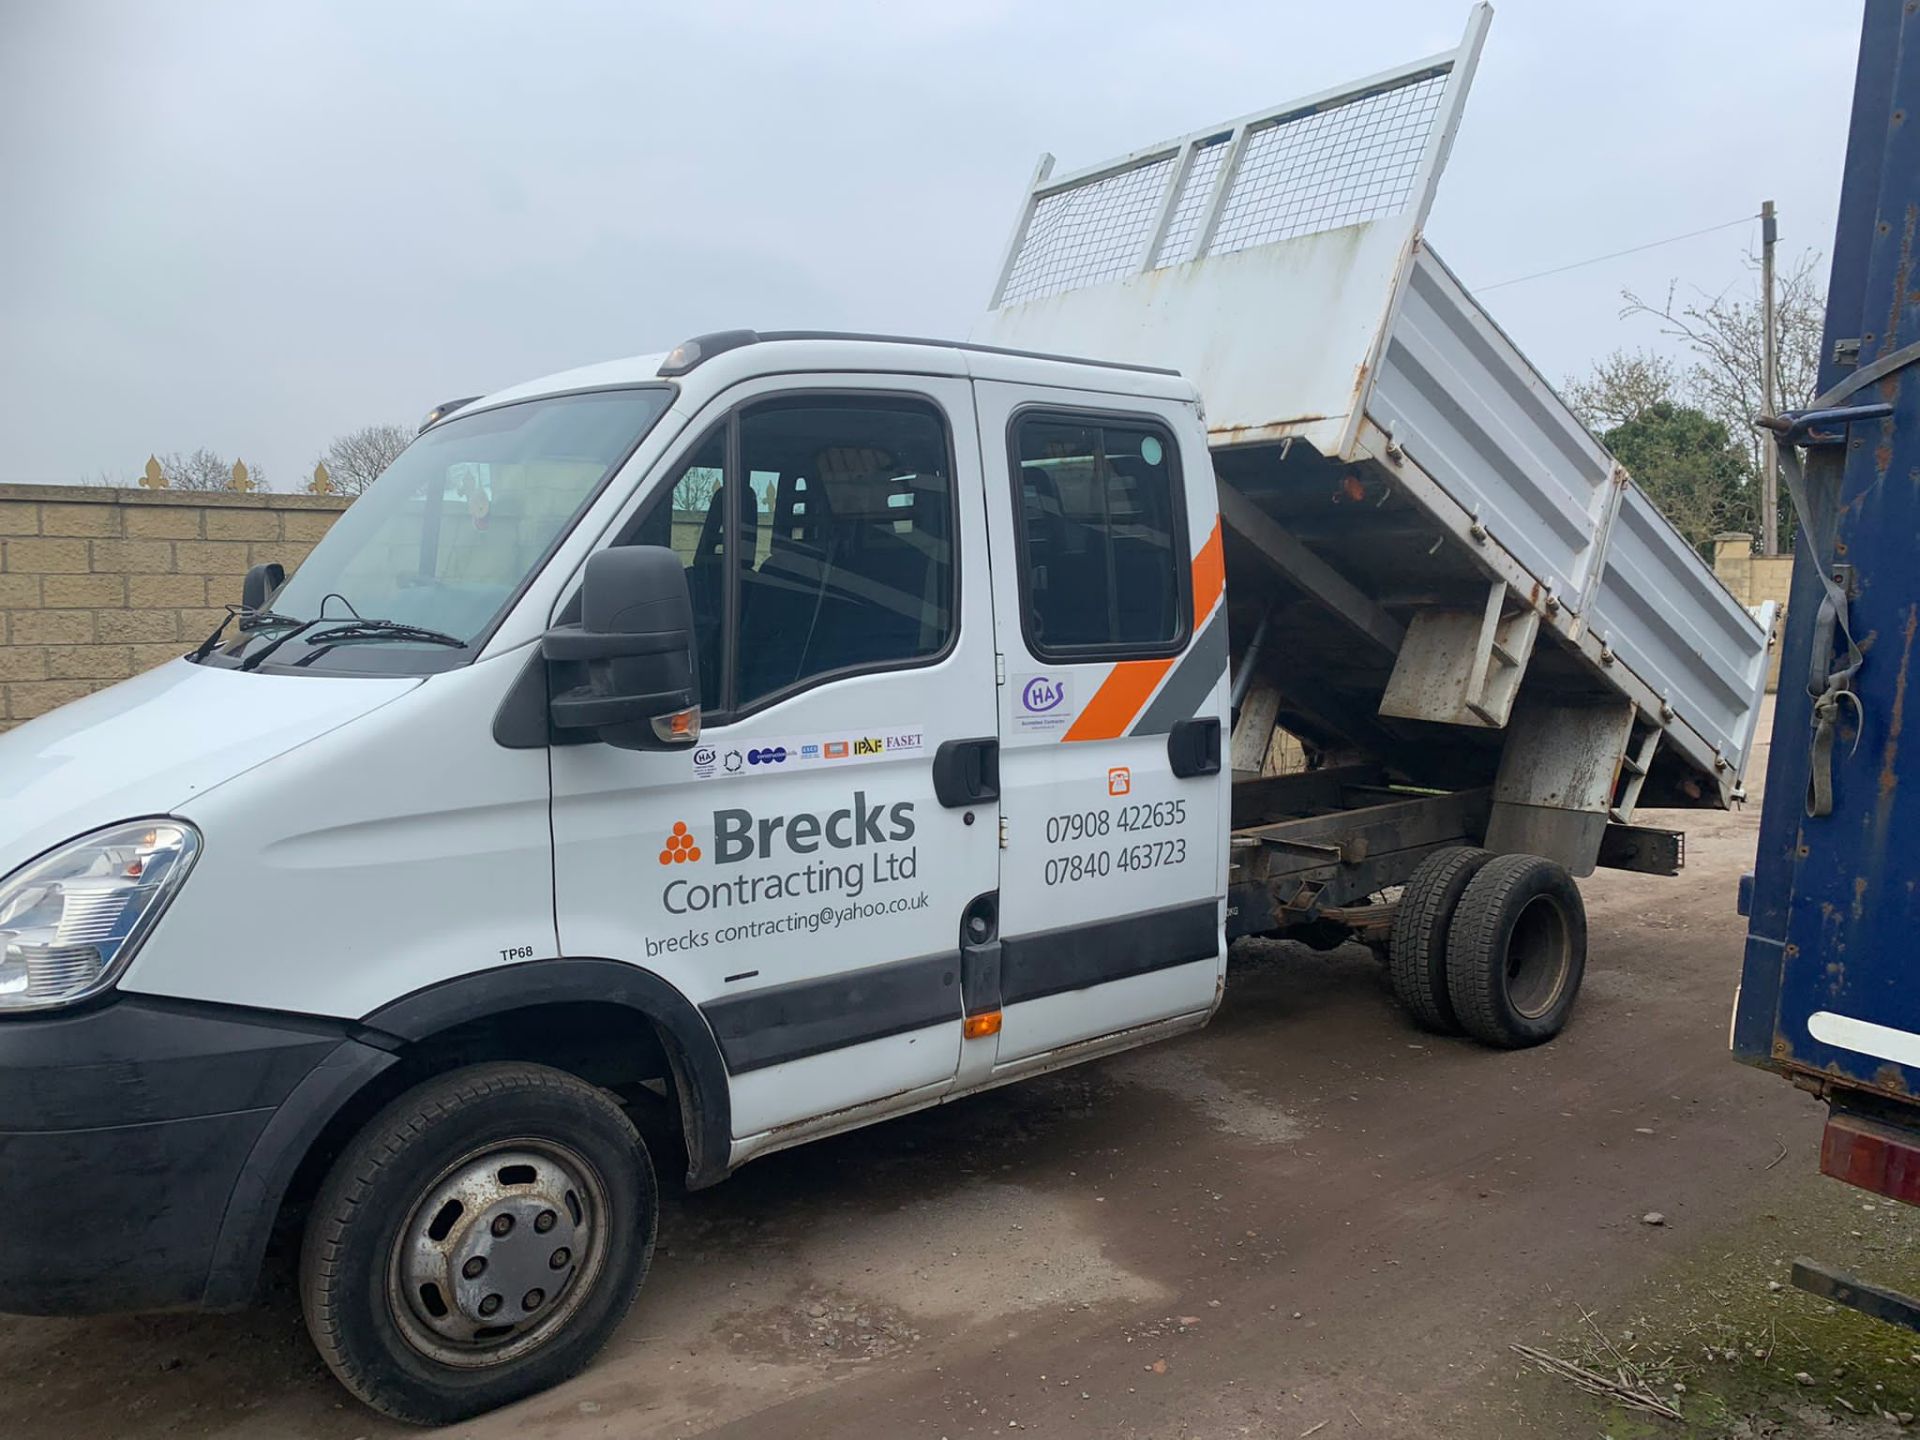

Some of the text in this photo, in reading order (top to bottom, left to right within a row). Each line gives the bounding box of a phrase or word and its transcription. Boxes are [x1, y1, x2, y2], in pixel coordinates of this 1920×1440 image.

[1022, 676, 1064, 712] CHAS
[693, 748, 716, 765] CHAS
[853, 736, 882, 755] IPAF
[886, 734, 923, 748] FASET
[713, 791, 915, 864] Brecks
[1046, 799, 1186, 843] 07908 422635
[662, 846, 917, 914] Contracting Ltd
[1045, 838, 1186, 886] 07840 463723
[645, 891, 929, 957] brecks contracting@yahoo.co.uk
[500, 945, 533, 961] TP68
